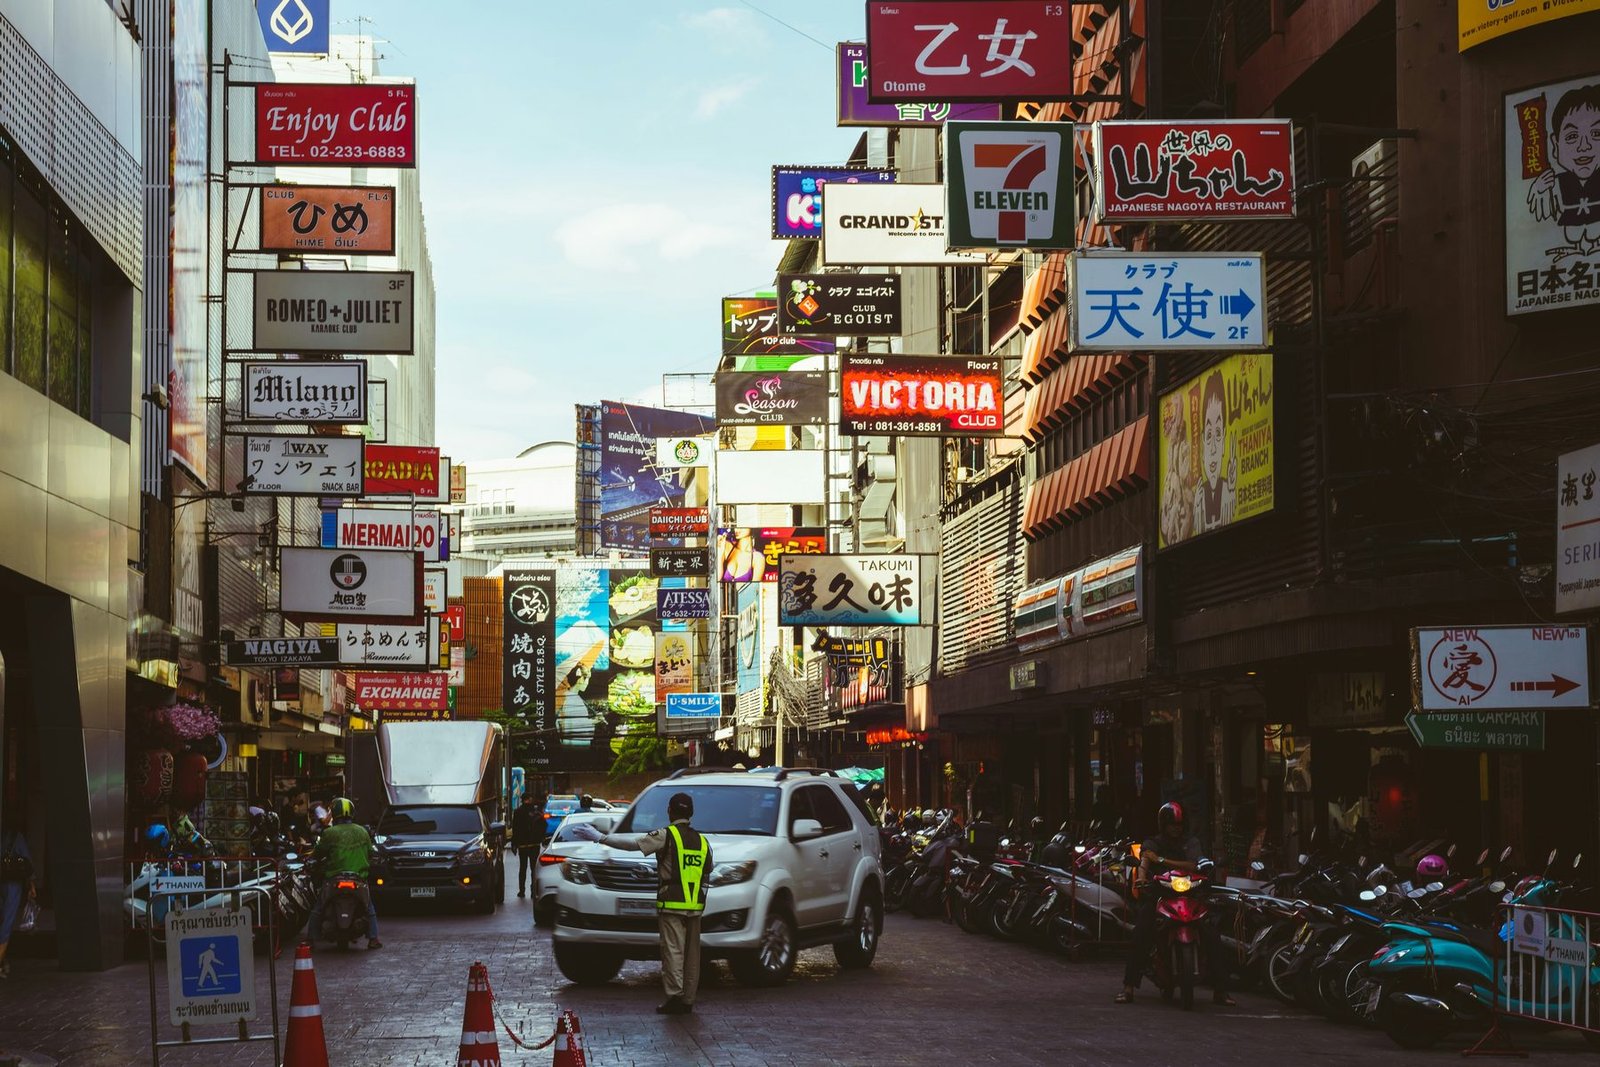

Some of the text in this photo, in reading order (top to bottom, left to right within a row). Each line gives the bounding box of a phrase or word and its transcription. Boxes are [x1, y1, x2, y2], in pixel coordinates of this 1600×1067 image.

[1045, 5, 1063, 17] F.3
[913, 18, 1038, 78] 乙女
[883, 80, 926, 92] Otome
[387, 90, 393, 98] 5
[266, 102, 407, 144] Enjoy Club
[1162, 129, 1233, 156] 世界の
[268, 145, 406, 158] TEL. 02-233-6883
[879, 172, 890, 181] F5
[1109, 143, 1284, 201] 山ちゃん
[266, 190, 295, 200] CLUB
[1108, 200, 1287, 213] JAPANESE NAGOYA RESTAURANT
[287, 200, 369, 235] ひめ
[839, 214, 910, 230] GRAND
[296, 238, 324, 247] HIME
[1125, 261, 1179, 280] クラブ
[388, 279, 405, 291] 3F
[828, 286, 895, 298] クラブ エゴイスト
[1515, 292, 1572, 309] JAPANESE
[852, 304, 877, 312] CLUB
[1085, 281, 1216, 340] 天使
[833, 313, 893, 325] EGOIST
[311, 323, 358, 333] KARAOKE CLUB
[785, 325, 796, 333] F.4
[1227, 326, 1249, 340] 2F
[762, 336, 797, 345] TOP club
[967, 361, 999, 370] Floor 2
[254, 374, 356, 403] Milano
[850, 379, 997, 411] VICTORIA
[760, 414, 784, 422] CLUB
[957, 414, 997, 427] CLUB
[875, 421, 942, 432] 081-361-8581
[1238, 424, 1273, 457] THANIYA
[1240, 447, 1269, 475] BRANCH
[321, 482, 360, 492] SNACK BAR
[651, 515, 707, 524] DAIICHI CLUB
[657, 556, 704, 570] 新世界
[858, 560, 913, 571] TAKUMI
[787, 571, 914, 617] 多久味
[1443, 629, 1479, 642] NEW
[1532, 628, 1566, 642] NEW
[244, 640, 321, 655] NAGIYA
[657, 658, 691, 675] まとい
[1442, 644, 1486, 692] 愛
[536, 666, 545, 695] STYLE
[360, 686, 443, 699] EXCHANGE
[1457, 695, 1471, 706] AI
[683, 853, 702, 870] pcs
[164, 877, 204, 889] THANIYA
[1555, 947, 1585, 960] THANIYA
